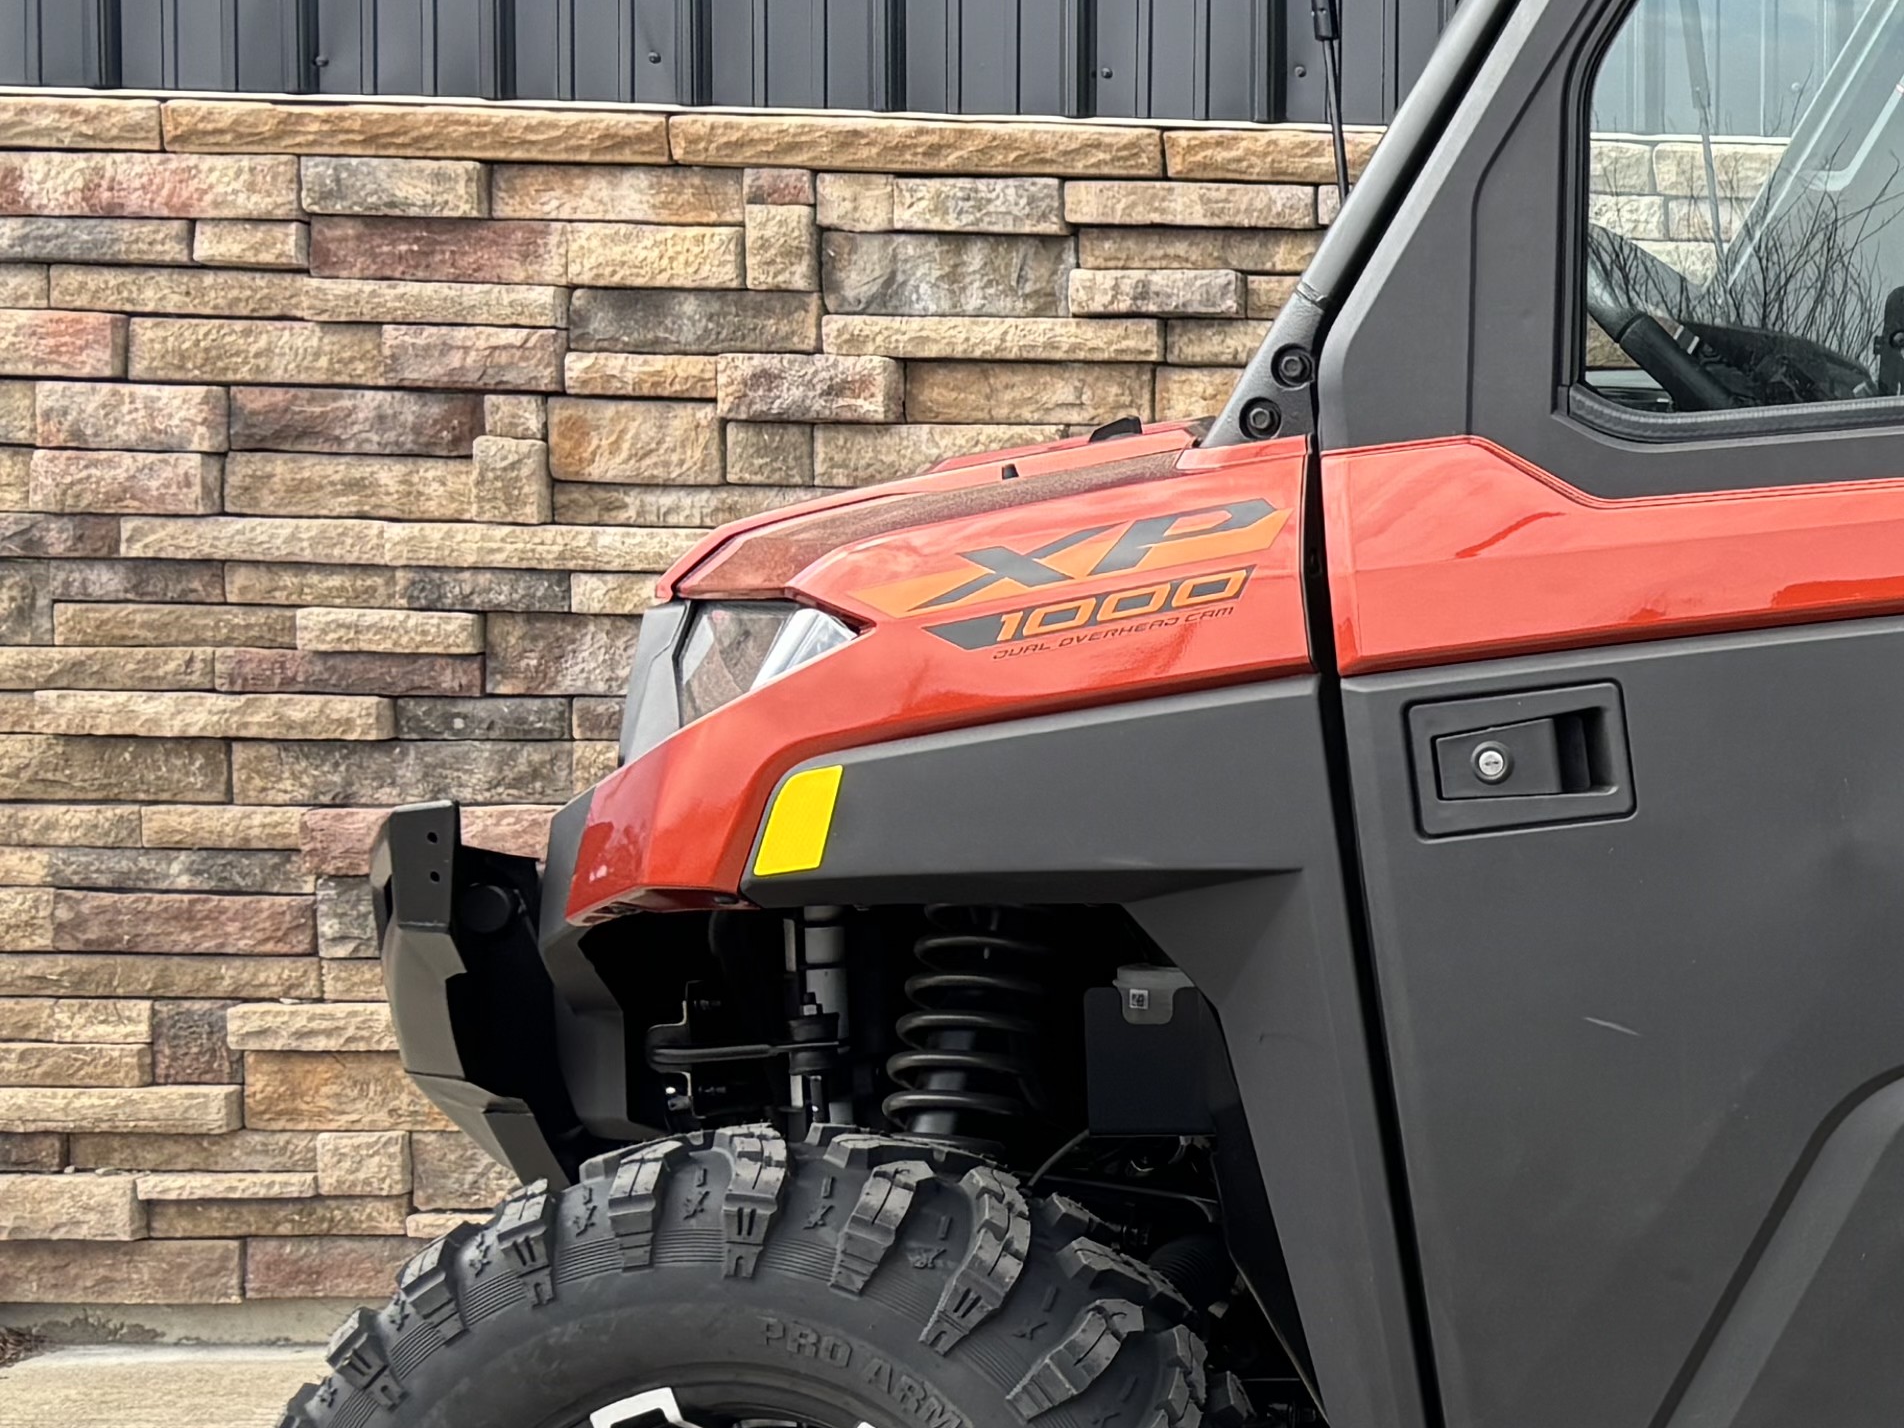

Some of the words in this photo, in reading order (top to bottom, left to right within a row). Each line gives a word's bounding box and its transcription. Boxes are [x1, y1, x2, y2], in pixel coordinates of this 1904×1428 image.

[906, 498, 1276, 612] XP
[993, 644, 1051, 660] DUAL
[1058, 617, 1178, 647] OVERHEAD
[1184, 606, 1234, 623] CAM
[996, 570, 1248, 642] 1000
[763, 1319, 853, 1368] PRO
